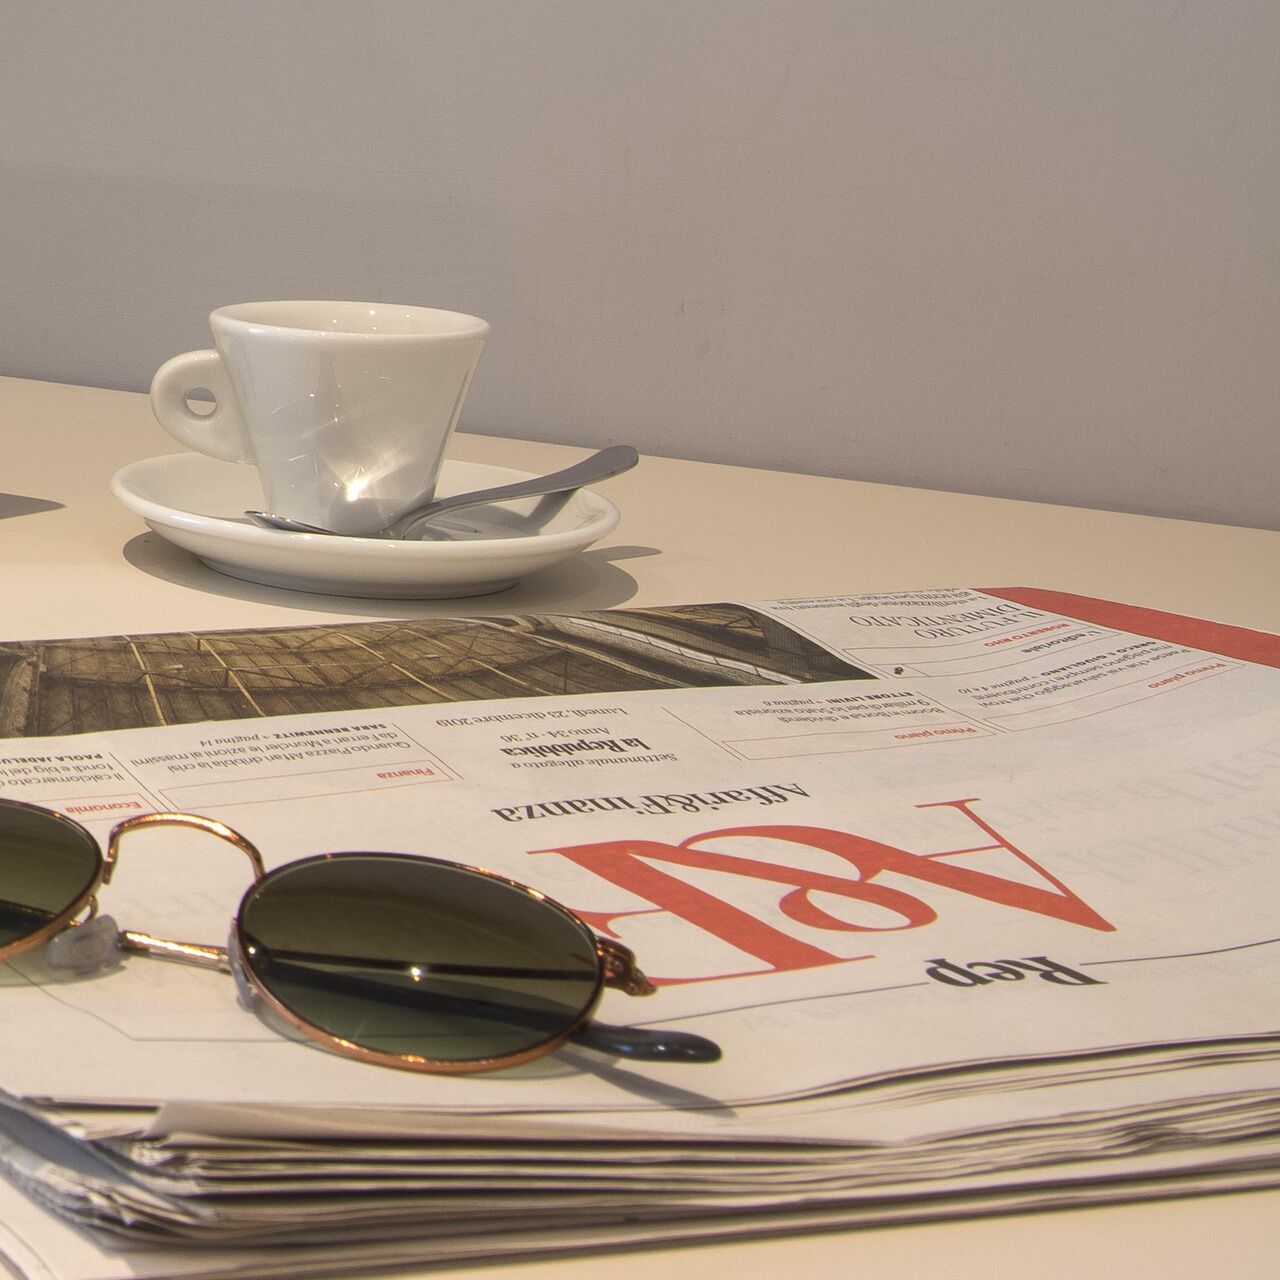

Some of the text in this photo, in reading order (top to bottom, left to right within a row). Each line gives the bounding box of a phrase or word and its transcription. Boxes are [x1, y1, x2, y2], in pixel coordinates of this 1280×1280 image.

[849, 604, 1020, 628] DIMENTICATO
[914, 617, 1013, 639] FUTURO
[1147, 662, 1227, 690] Primo piano
[473, 712, 547, 726] dicembre
[381, 731, 398, 741] da
[569, 727, 611, 738] Anno
[894, 726, 977, 741] Primo piano
[304, 747, 350, 759] Piazza
[349, 741, 411, 755] Quando
[500, 738, 651, 759] la Repubblica
[264, 750, 304, 762] Affari
[586, 753, 678, 768] Settimanale
[34, 763, 60, 777] big
[523, 758, 585, 770] allegato
[8, 767, 32, 778] del
[375, 767, 435, 780] Finanza
[7, 772, 113, 788] calciomercato
[65, 799, 142, 816] Economia
[490, 783, 811, 822] Affari&Finanza
[923, 956, 1109, 988] Rep
